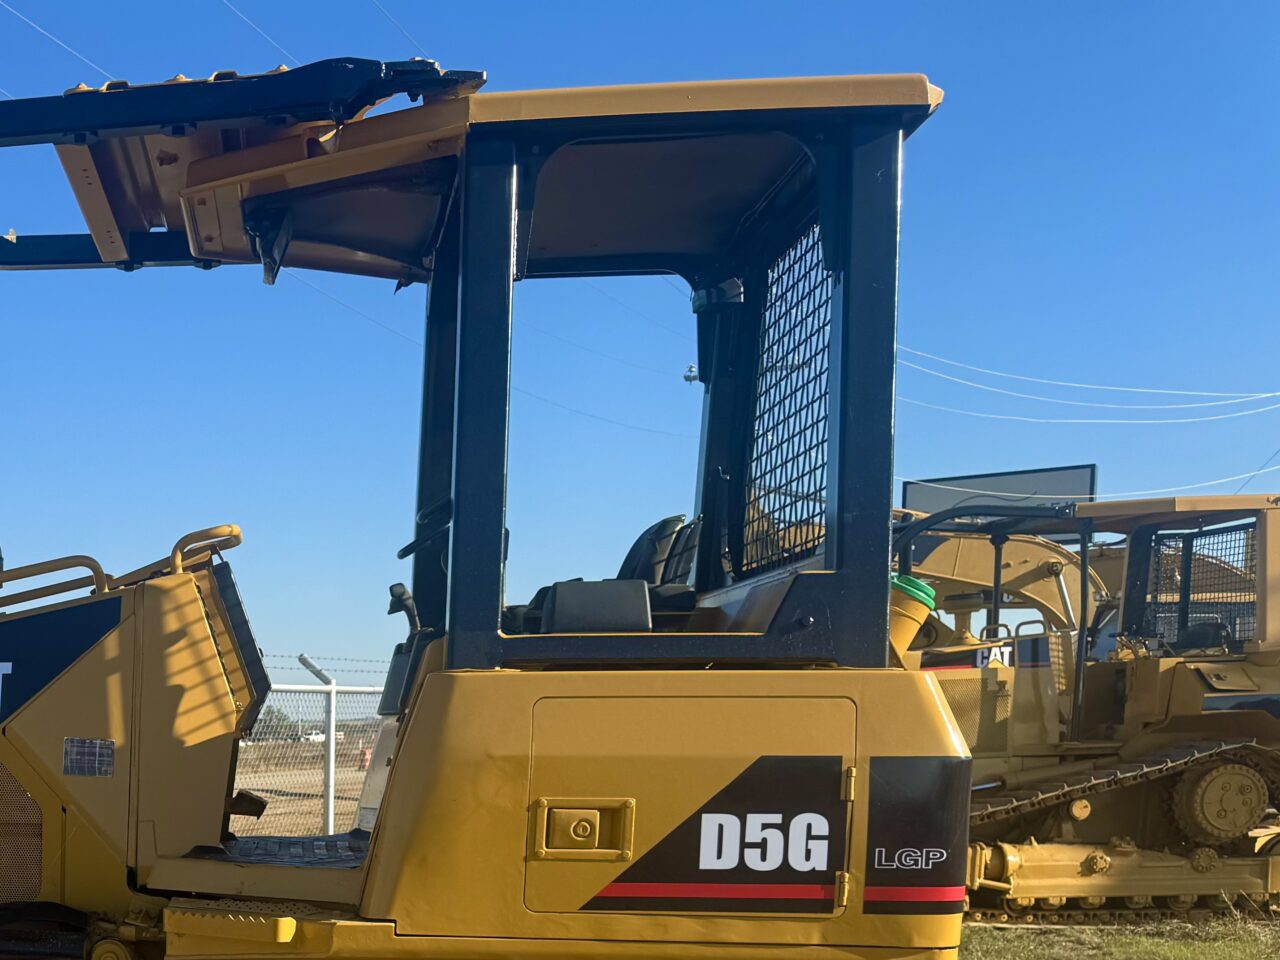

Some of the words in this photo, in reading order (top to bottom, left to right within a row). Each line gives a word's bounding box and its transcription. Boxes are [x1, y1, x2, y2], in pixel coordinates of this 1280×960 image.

[976, 646, 1013, 669] CAT
[697, 812, 830, 872] D5G
[874, 847, 948, 870] LGP
